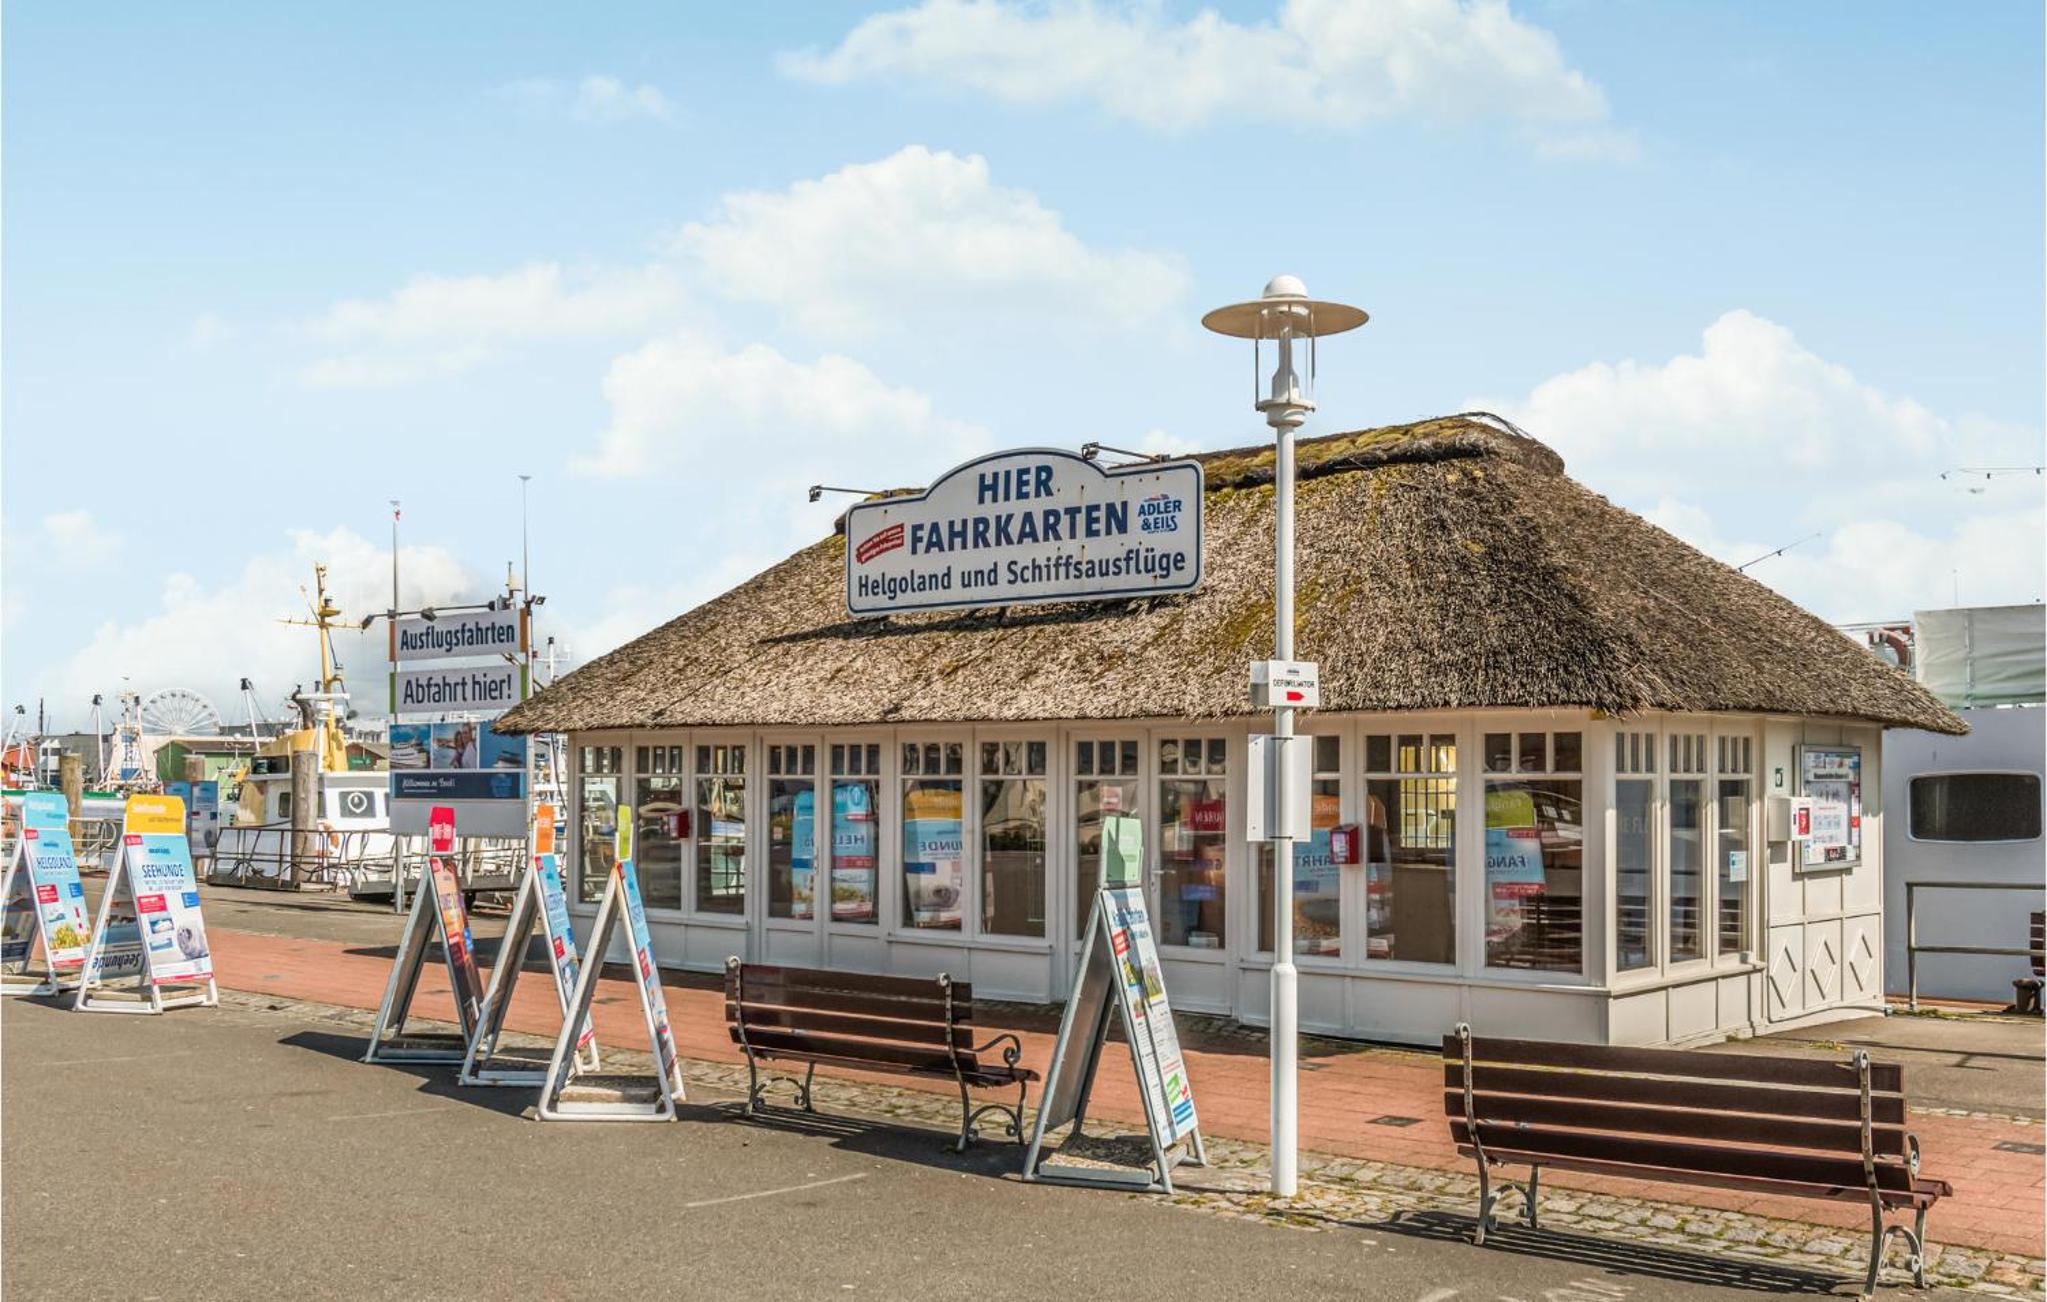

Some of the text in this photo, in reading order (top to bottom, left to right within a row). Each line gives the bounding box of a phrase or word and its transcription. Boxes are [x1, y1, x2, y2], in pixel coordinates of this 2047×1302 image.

[978, 464, 1055, 505] HIER
[1137, 500, 1183, 518] ADLER
[910, 501, 1129, 556] FAHRKARTEN
[858, 547, 1186, 601] Helgoland und Schiffsausflüge
[400, 621, 515, 653] Ausflugsfahrten
[403, 673, 512, 705] Abfahrt hier!
[36, 856, 72, 870] HELGOLAND
[141, 864, 185, 878] SEEHUNDE
